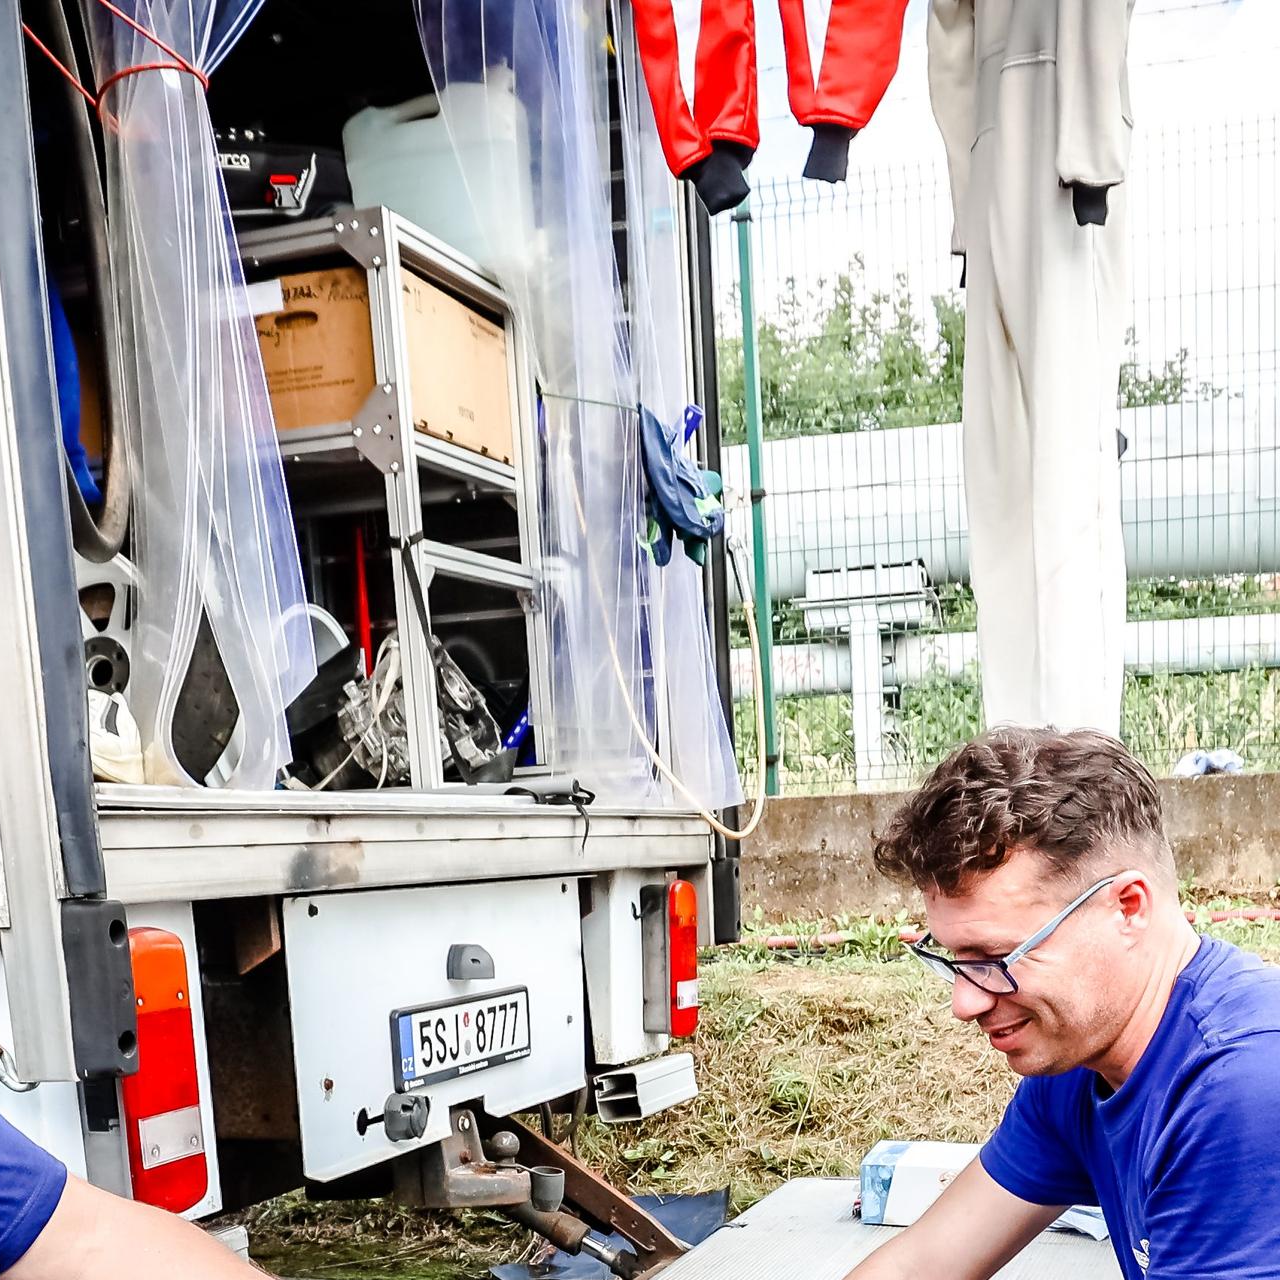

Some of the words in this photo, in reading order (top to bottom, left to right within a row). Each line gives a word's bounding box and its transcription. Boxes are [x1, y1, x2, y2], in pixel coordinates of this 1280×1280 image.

[419, 1013, 460, 1068] 5SJ
[475, 1001, 518, 1053] 8777
[401, 1056, 414, 1072] CZ
